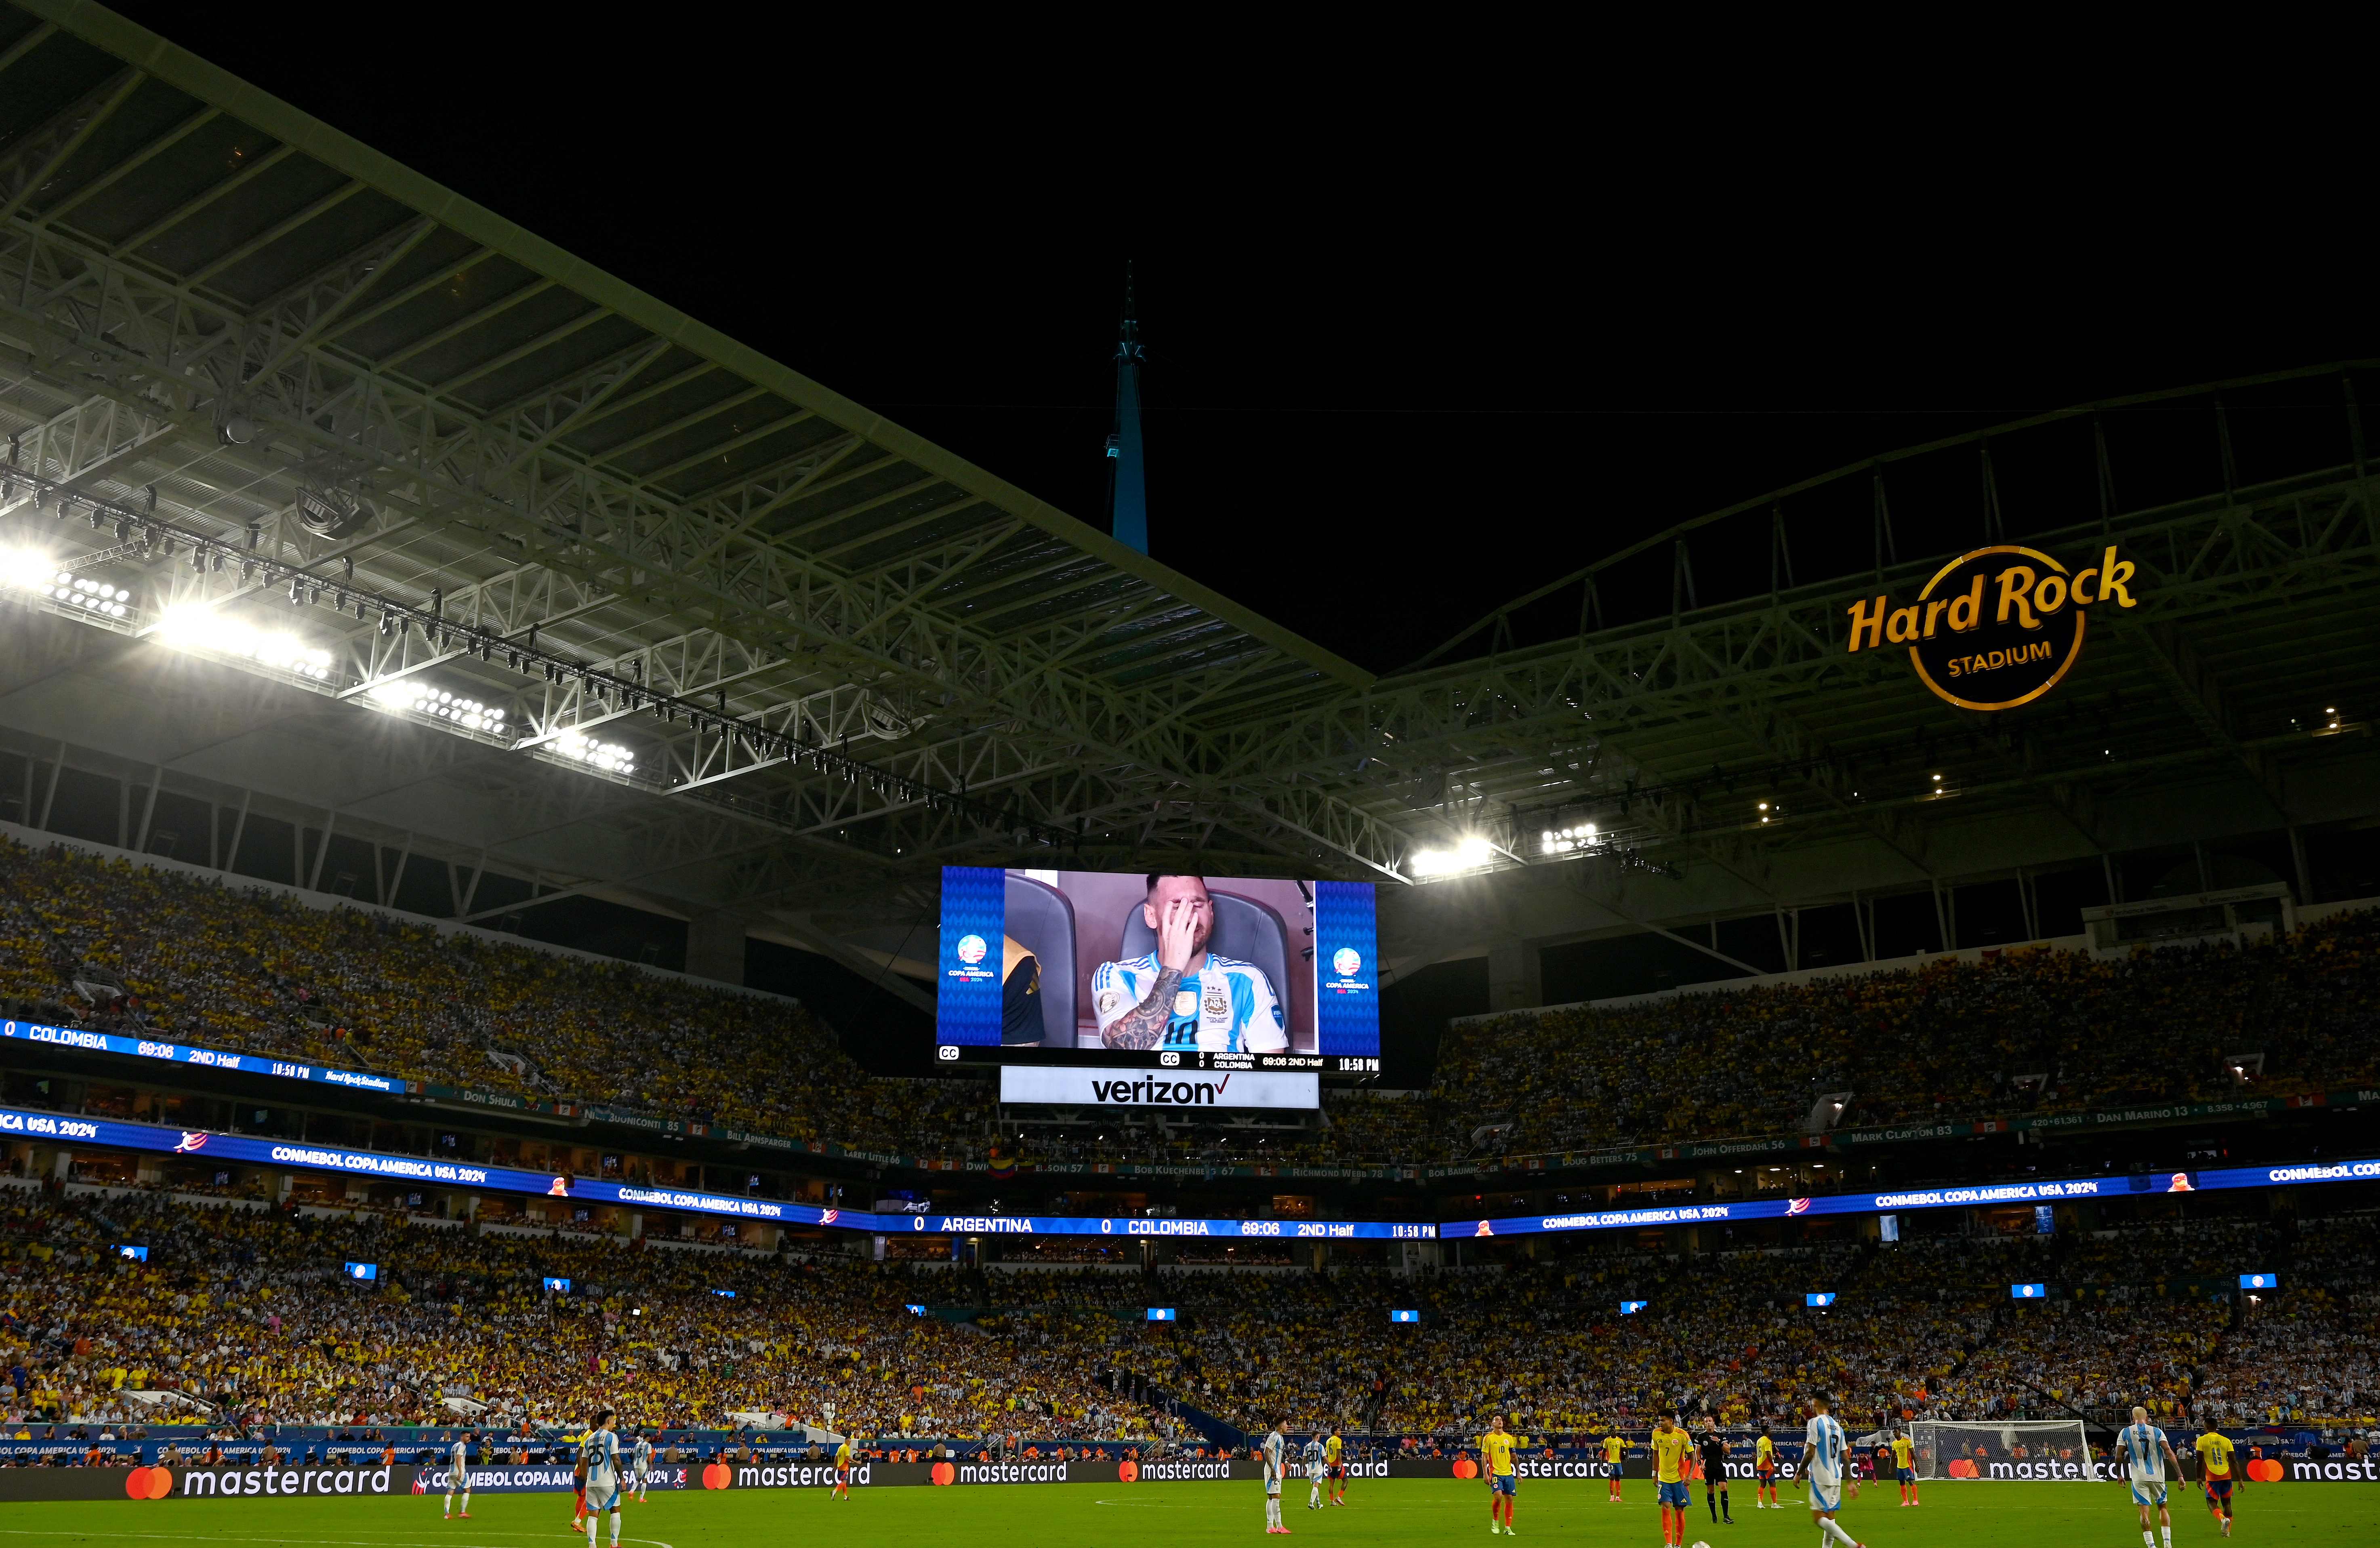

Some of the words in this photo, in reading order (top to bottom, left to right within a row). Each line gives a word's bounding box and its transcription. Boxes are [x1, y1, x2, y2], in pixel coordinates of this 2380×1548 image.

[1847, 573, 1987, 652] Hard
[1994, 545, 2138, 631] Rock
[1948, 640, 2052, 677] STADIUM
[4, 1021, 16, 1036] 0
[29, 1025, 107, 1050] COLOMBIA
[138, 1040, 174, 1059] 69:06
[188, 1050, 214, 1068] 2ND
[217, 1054, 241, 1069] Half
[272, 1062, 295, 1078] 10:58
[297, 1066, 310, 1079] PM
[942, 1048, 956, 1058] CC
[1163, 1053, 1177, 1064] CC
[1213, 1053, 1255, 1062] ARGENTINA
[1214, 1061, 1253, 1069] COLOMBIA
[1263, 1057, 1286, 1066] 69:06
[1288, 1058, 1306, 1066] 2ND
[1308, 1058, 1323, 1067] Half
[1339, 1058, 1363, 1071] 10:58
[1367, 1059, 1379, 1071] PM
[325, 1071, 345, 1081] Hard
[344, 1073, 361, 1086] Rock
[360, 1075, 390, 1090] Stadium
[1092, 1074, 1215, 1104] verizon
[464, 1090, 485, 1102] DON
[489, 1094, 517, 1108] SHULA
[2031, 1119, 2048, 1127] 420
[2097, 1113, 2121, 1123] DAN
[2125, 1109, 2171, 1121] MARINO
[2174, 1106, 2188, 1117] 13
[27, 1117, 57, 1134] USA
[59, 1121, 96, 1138] 2024
[667, 1121, 679, 1131] 85
[1852, 1133, 1884, 1143] MARK
[1937, 1126, 1953, 1136] 83
[727, 1131, 742, 1141] BILL
[744, 1134, 791, 1149] ARNSPARGER
[1692, 1146, 1716, 1157] JOHN
[1719, 1143, 1769, 1154] OFFERDAHL
[1771, 1140, 1785, 1150] 56
[271, 1146, 344, 1167] CONMEBOL
[345, 1155, 378, 1173] COPA
[378, 1159, 432, 1177] AMERICA
[435, 1165, 457, 1180] USA
[458, 1168, 486, 1183] 2024
[843, 1149, 866, 1161] LARRY
[868, 1152, 889, 1163] LITTLE
[890, 1156, 900, 1165] 66
[1590, 1155, 1622, 1165] BETTERS
[1625, 1153, 1638, 1162] 75
[1071, 1164, 1083, 1172] 57
[1135, 1165, 1153, 1174] BOB
[1156, 1165, 1216, 1175] KUECHENBEG
[1222, 1167, 1235, 1176] 67
[1293, 1168, 1339, 1178] RICHMOND
[1342, 1169, 1367, 1178] WEBB
[1372, 1170, 1383, 1178] 78
[1429, 1169, 1445, 1178] BOB
[1448, 1165, 1499, 1176] BAUMHOER
[2269, 1165, 2353, 1182] CONMEBOL
[618, 1187, 673, 1205] CONMEBOL
[673, 1194, 699, 1207] COPA
[699, 1197, 740, 1212] AMERICA
[742, 1202, 758, 1214] USA
[759, 1204, 781, 1217] 2024
[1875, 1191, 1944, 1207] CONMEBOL
[1945, 1189, 1978, 1203] COPA
[1978, 1186, 2037, 1200] AMERICA
[2040, 1184, 2064, 1196] USA
[2065, 1182, 2098, 1194] 2024
[1542, 1215, 1600, 1229] CONMEBOL
[1601, 1213, 1630, 1226] COPA
[1630, 1210, 1677, 1224] AMERICA
[1680, 1208, 1700, 1220] USA
[1701, 1206, 1728, 1218] 2024
[914, 1216, 925, 1231] 0
[941, 1218, 1032, 1233] ARGENTINA
[1101, 1219, 1112, 1234] 0
[1128, 1220, 1209, 1235] COLOMBIA
[1241, 1221, 1280, 1235] 69:06
[1297, 1224, 1326, 1236] 2ND
[1329, 1224, 1354, 1237] Half
[1392, 1225, 1419, 1237] 10:58
[1423, 1226, 1436, 1238] PM
[588, 1443, 604, 1467] 25
[1308, 1450, 1318, 1462] 20
[1665, 1447, 1669, 1457] 7
[2138, 1438, 2149, 1460] 7
[2212, 1447, 2222, 1466] 11
[960, 1461, 1066, 1483] mastercard
[1142, 1460, 1230, 1479] mastercard
[184, 1465, 390, 1495] mastercard
[432, 1471, 512, 1488] COMEBOL
[513, 1471, 550, 1486] COPA
[1493, 1476, 1498, 1484] 10
[1658, 1484, 1663, 1494] 7
